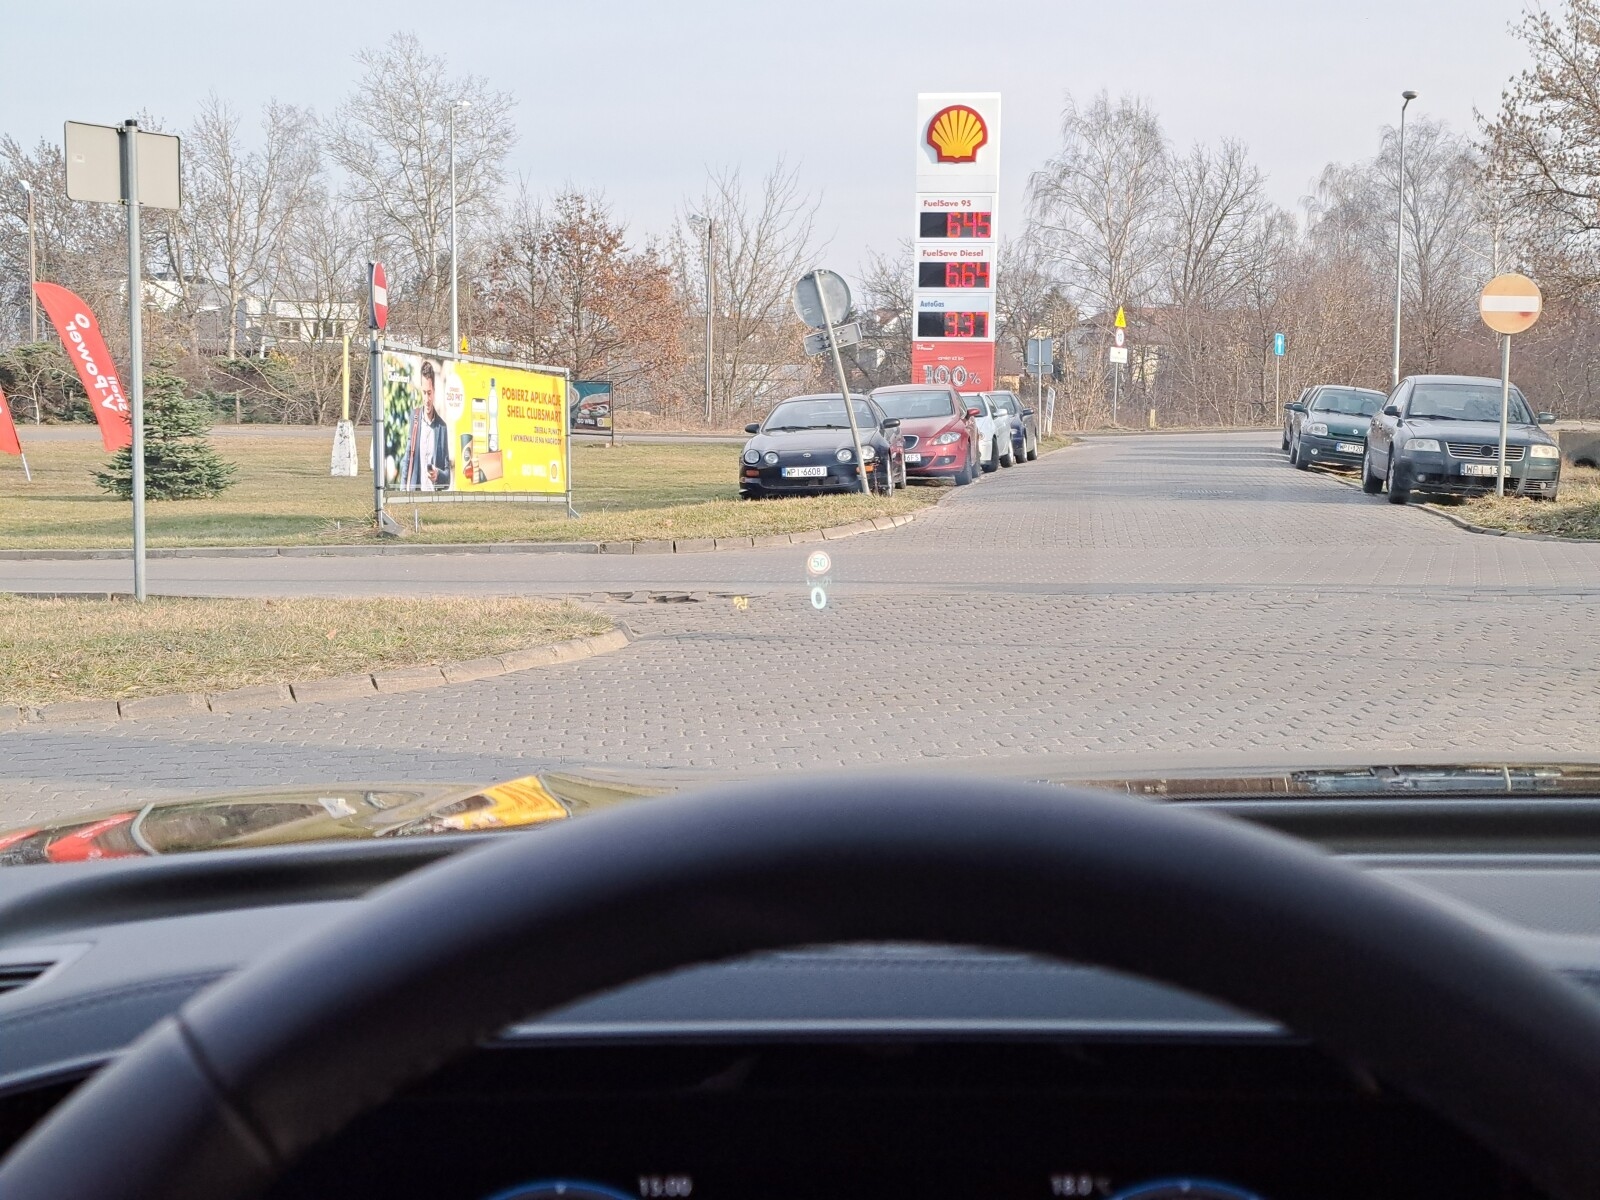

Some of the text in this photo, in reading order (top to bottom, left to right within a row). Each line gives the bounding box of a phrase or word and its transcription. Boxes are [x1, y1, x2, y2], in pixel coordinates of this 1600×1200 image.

[923, 199, 972, 207] FuelSave 95
[922, 249, 984, 257] FuelSave Diesel
[920, 300, 945, 308] AutoGas
[501, 387, 529, 402] POBIERZ
[507, 405, 562, 423] SHELL CLUBSMART
[810, 586, 827, 610] 0
